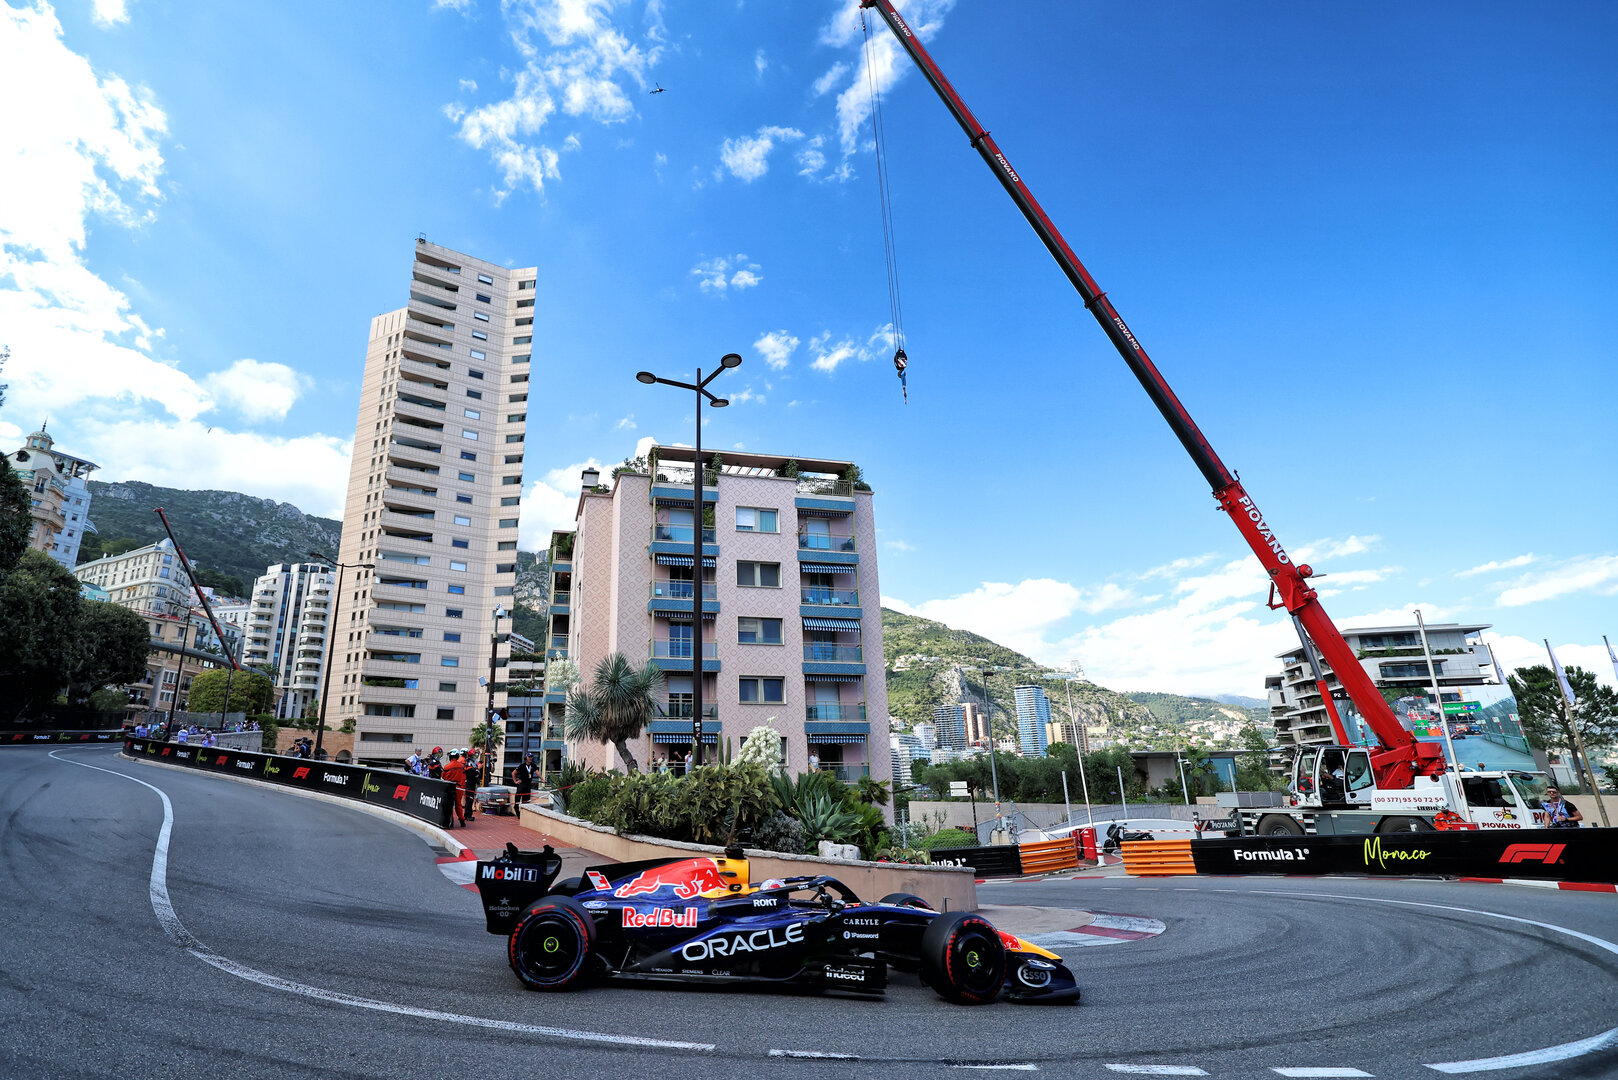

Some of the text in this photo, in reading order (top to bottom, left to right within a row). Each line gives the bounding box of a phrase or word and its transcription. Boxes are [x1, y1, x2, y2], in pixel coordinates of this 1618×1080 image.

[891, 11, 912, 37] PIOVANO
[996, 153, 1019, 182] PIOVANO
[1114, 317, 1140, 350] PIOVANO
[1238, 496, 1290, 565] PIOVANO
[323, 772, 342, 784] Formula
[420, 792, 436, 809] Formula
[1233, 849, 1294, 860] Formula
[1363, 836, 1432, 869] Monaco
[1498, 843, 1567, 865] F1
[482, 865, 522, 881] Mobil
[753, 898, 778, 907] ROKT
[622, 906, 698, 928] Red Bull
[843, 918, 879, 926] CARLYLE
[682, 922, 804, 961] ORACLE
[823, 964, 865, 982] indeed
